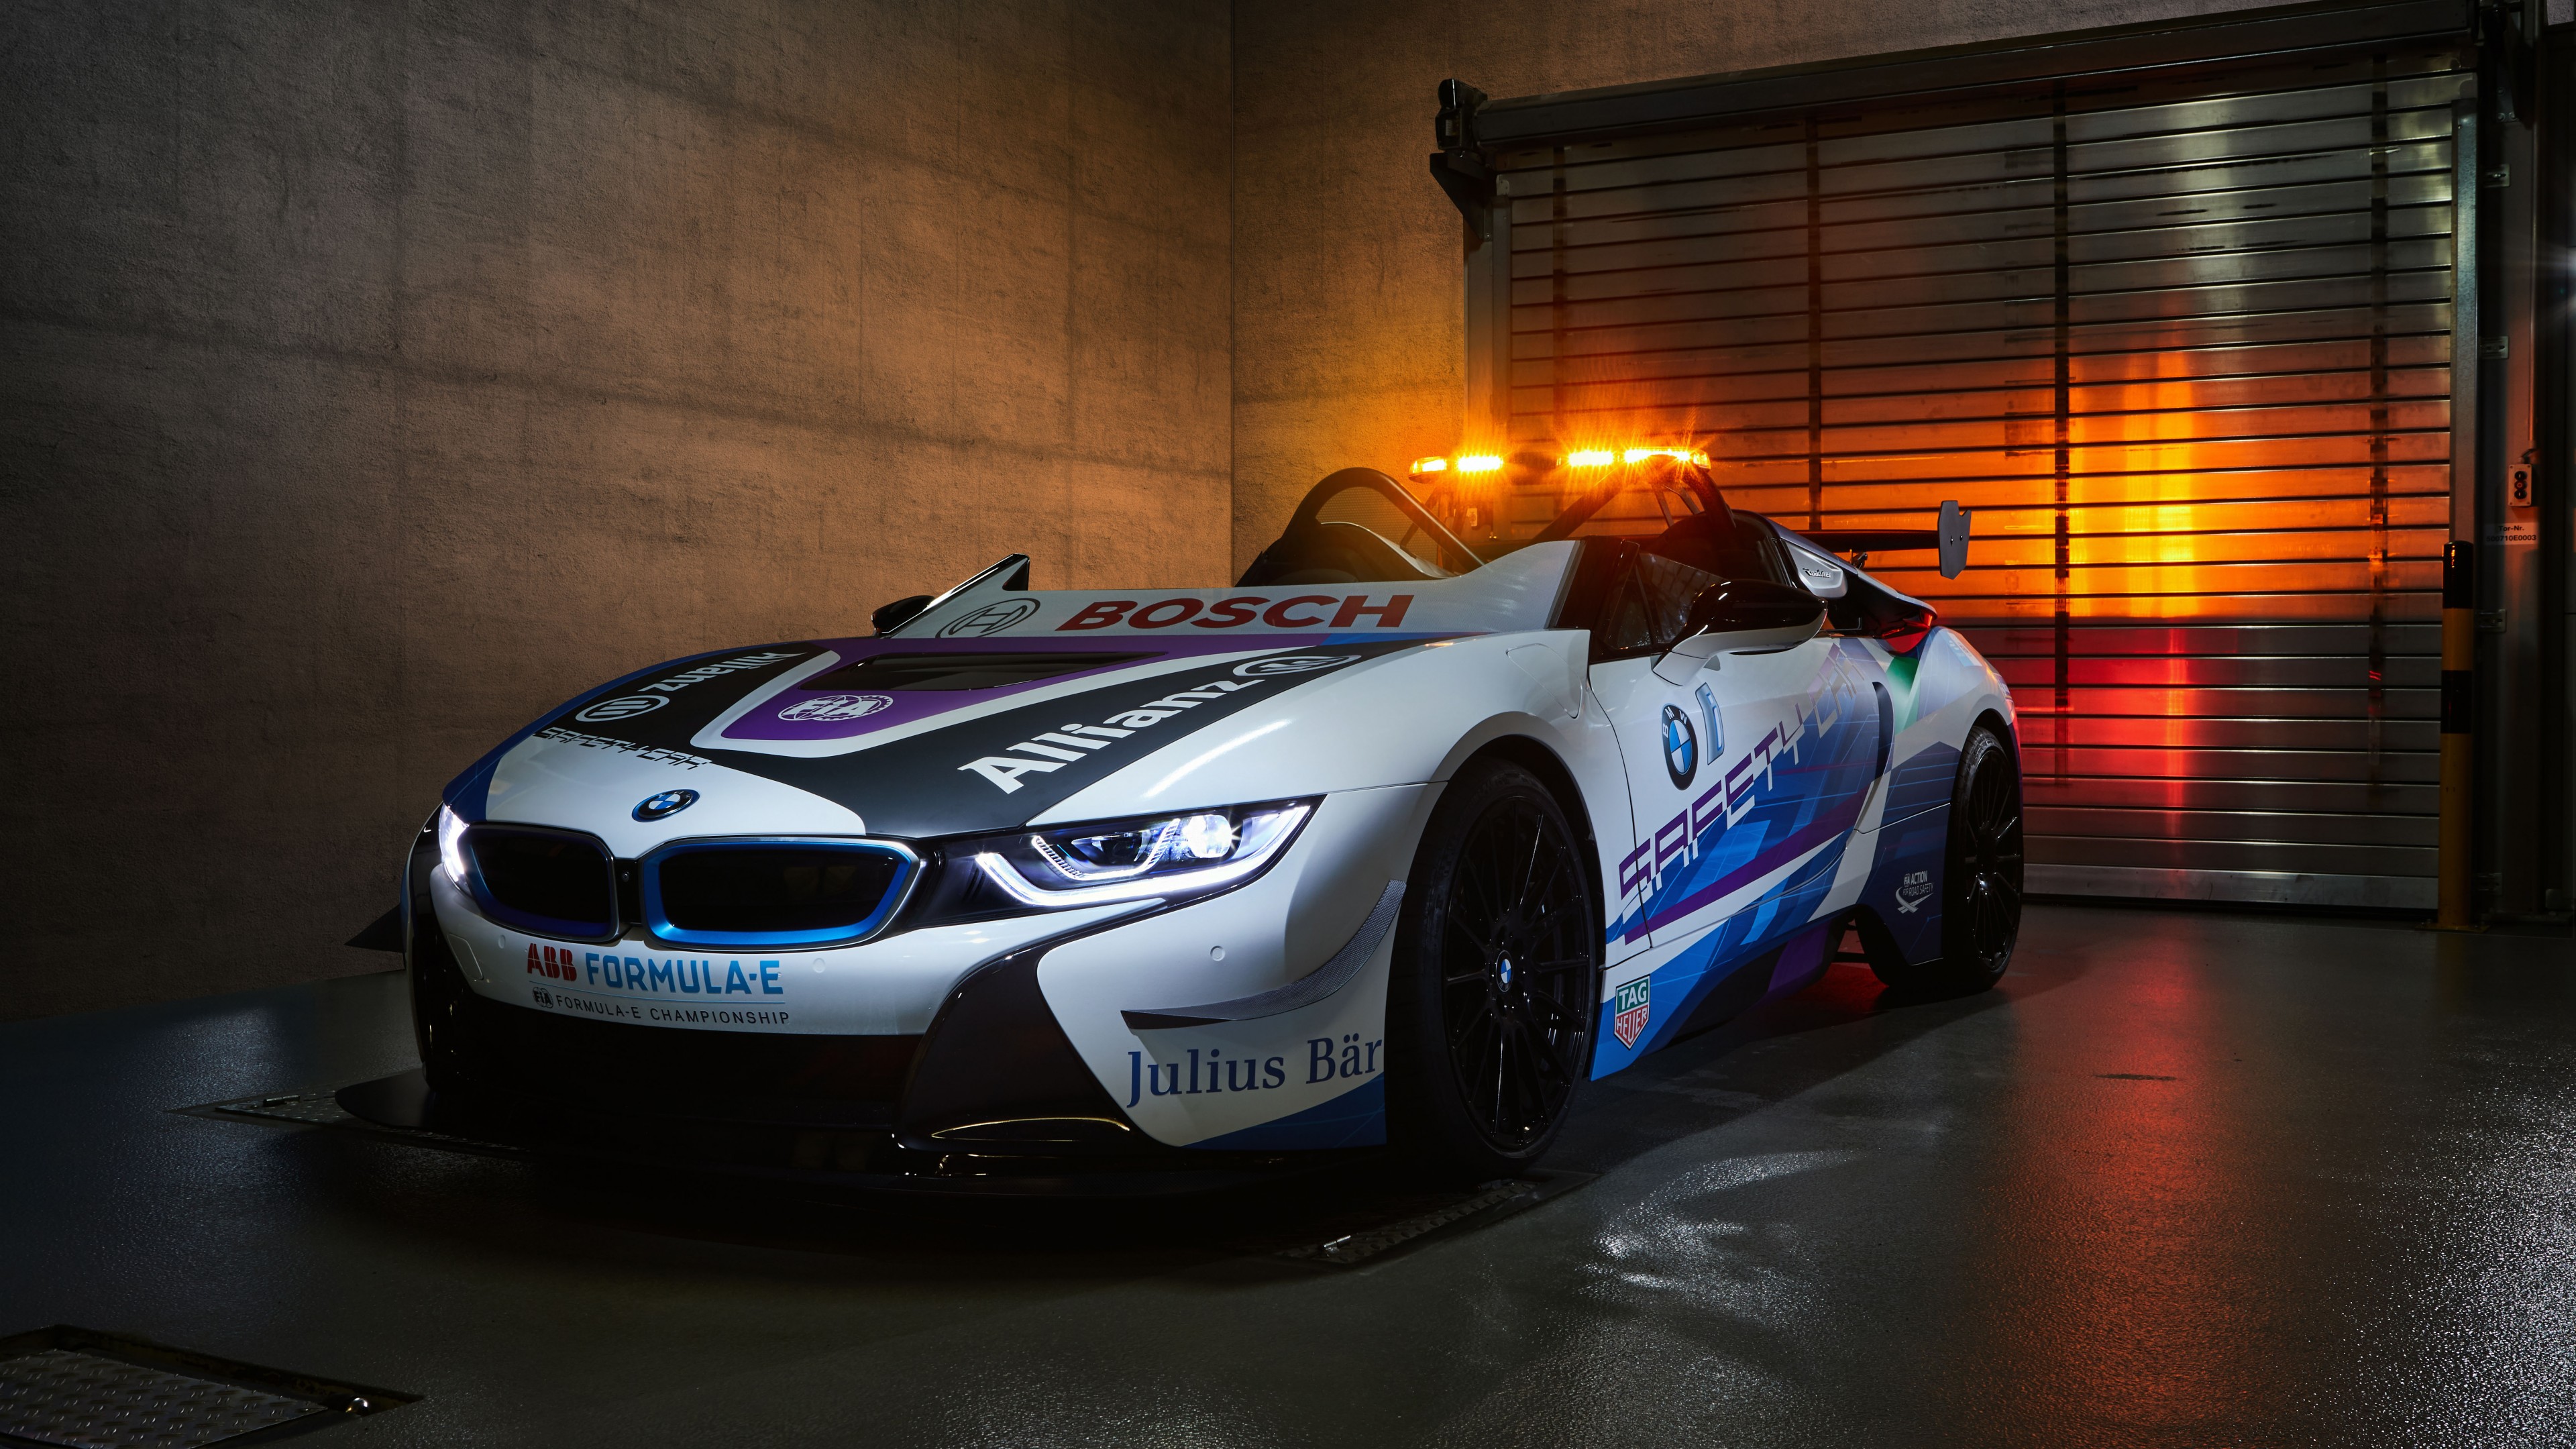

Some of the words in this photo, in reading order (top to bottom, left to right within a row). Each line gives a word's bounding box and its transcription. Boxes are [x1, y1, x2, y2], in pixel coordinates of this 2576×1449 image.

[1055, 594, 1414, 631] BOSCH
[638, 651, 807, 692] Allianz
[533, 727, 649, 753] SAFETY
[637, 747, 712, 769] CAR
[957, 678, 1265, 794] Allianz
[1619, 703, 1805, 924] SAFETY
[1909, 885, 1920, 897] ROAD
[1919, 882, 1934, 895] SAFETY
[1911, 870, 1928, 885] ACTION
[527, 943, 578, 981] ABB
[556, 995, 641, 1020] FORMULA-E
[650, 1008, 790, 1025] CHAMPIONSHIP
[1619, 982, 1647, 1010] TAG
[1617, 1007, 1648, 1043] HEUER
[1126, 1048, 1286, 1108] Julius
[1305, 1032, 1383, 1085] Bär
